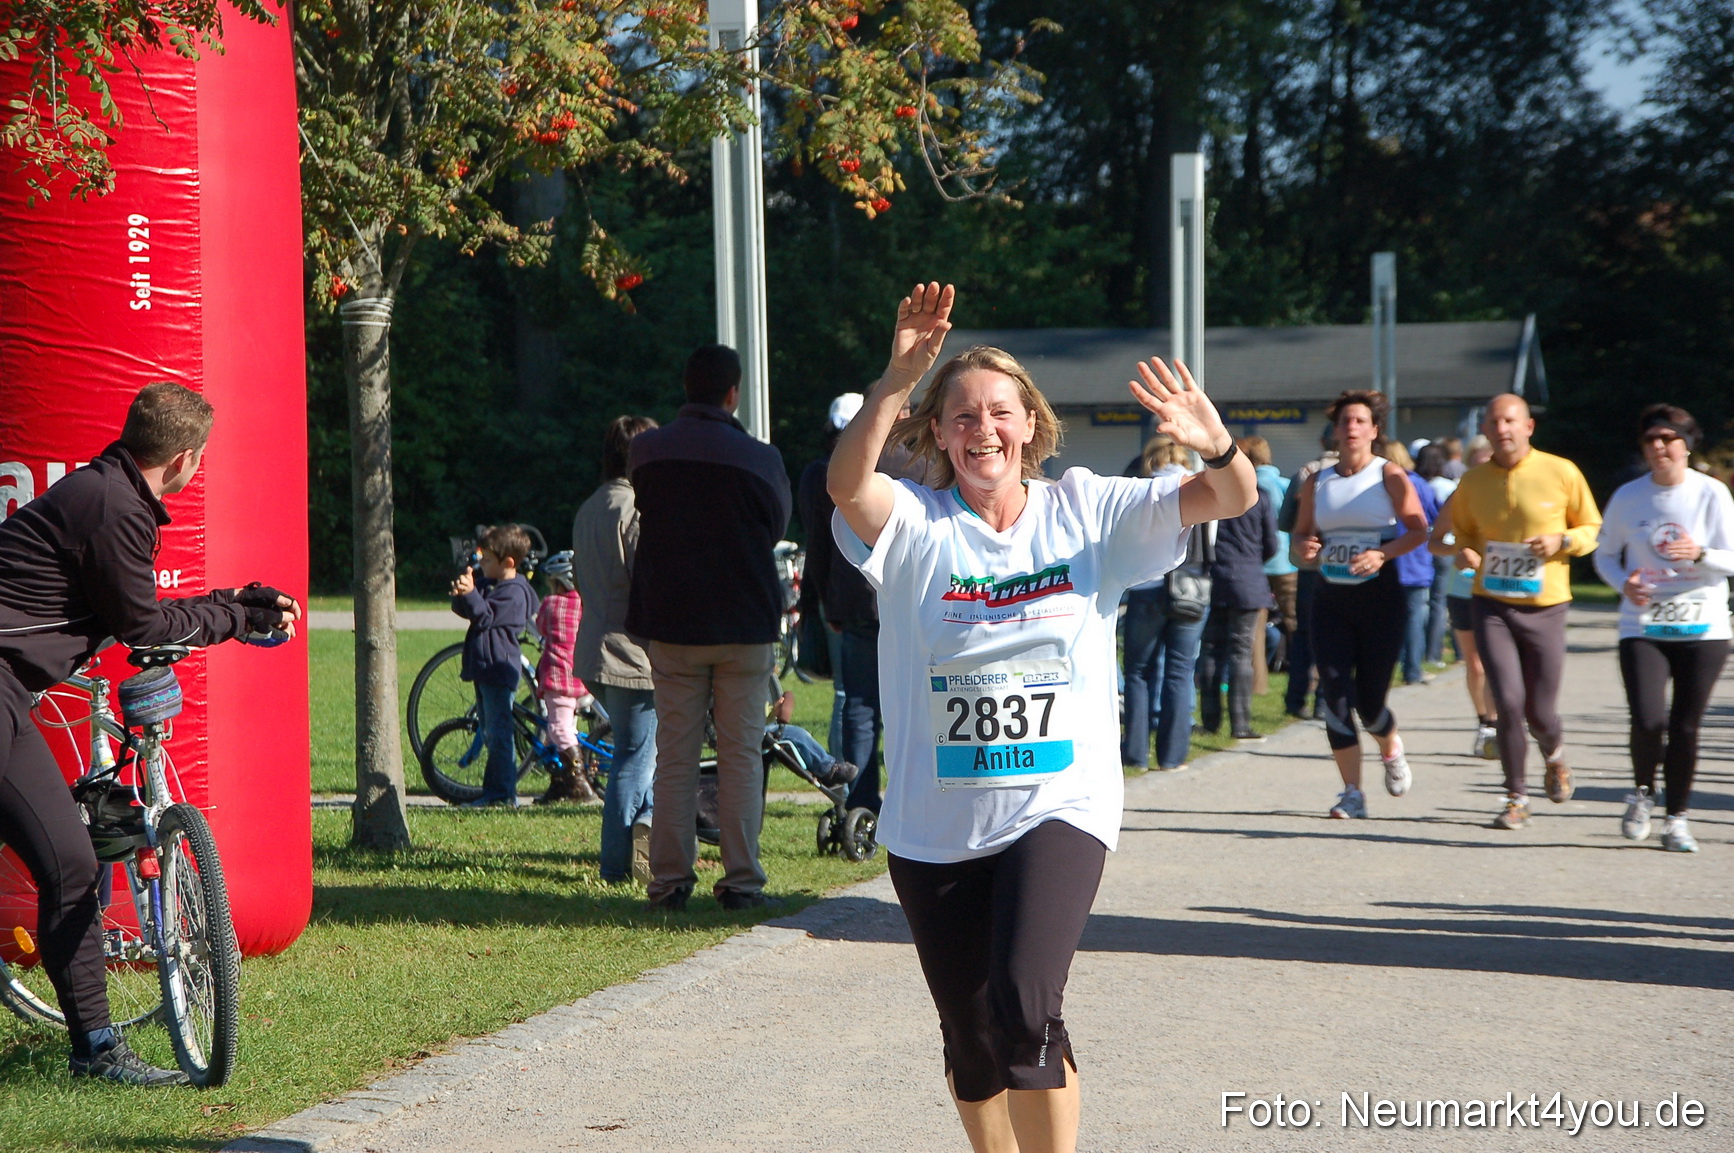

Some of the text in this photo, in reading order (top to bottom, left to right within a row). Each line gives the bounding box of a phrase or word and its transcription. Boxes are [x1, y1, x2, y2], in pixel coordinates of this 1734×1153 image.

[127, 213, 151, 311] Seit 1929
[1327, 544, 1371, 564] 206
[1490, 555, 1537, 577] 2128
[1651, 601, 1702, 622] 2827
[949, 673, 1008, 685] PFLEIDERER
[946, 692, 1056, 742] 2837
[973, 746, 1035, 771] Anita
